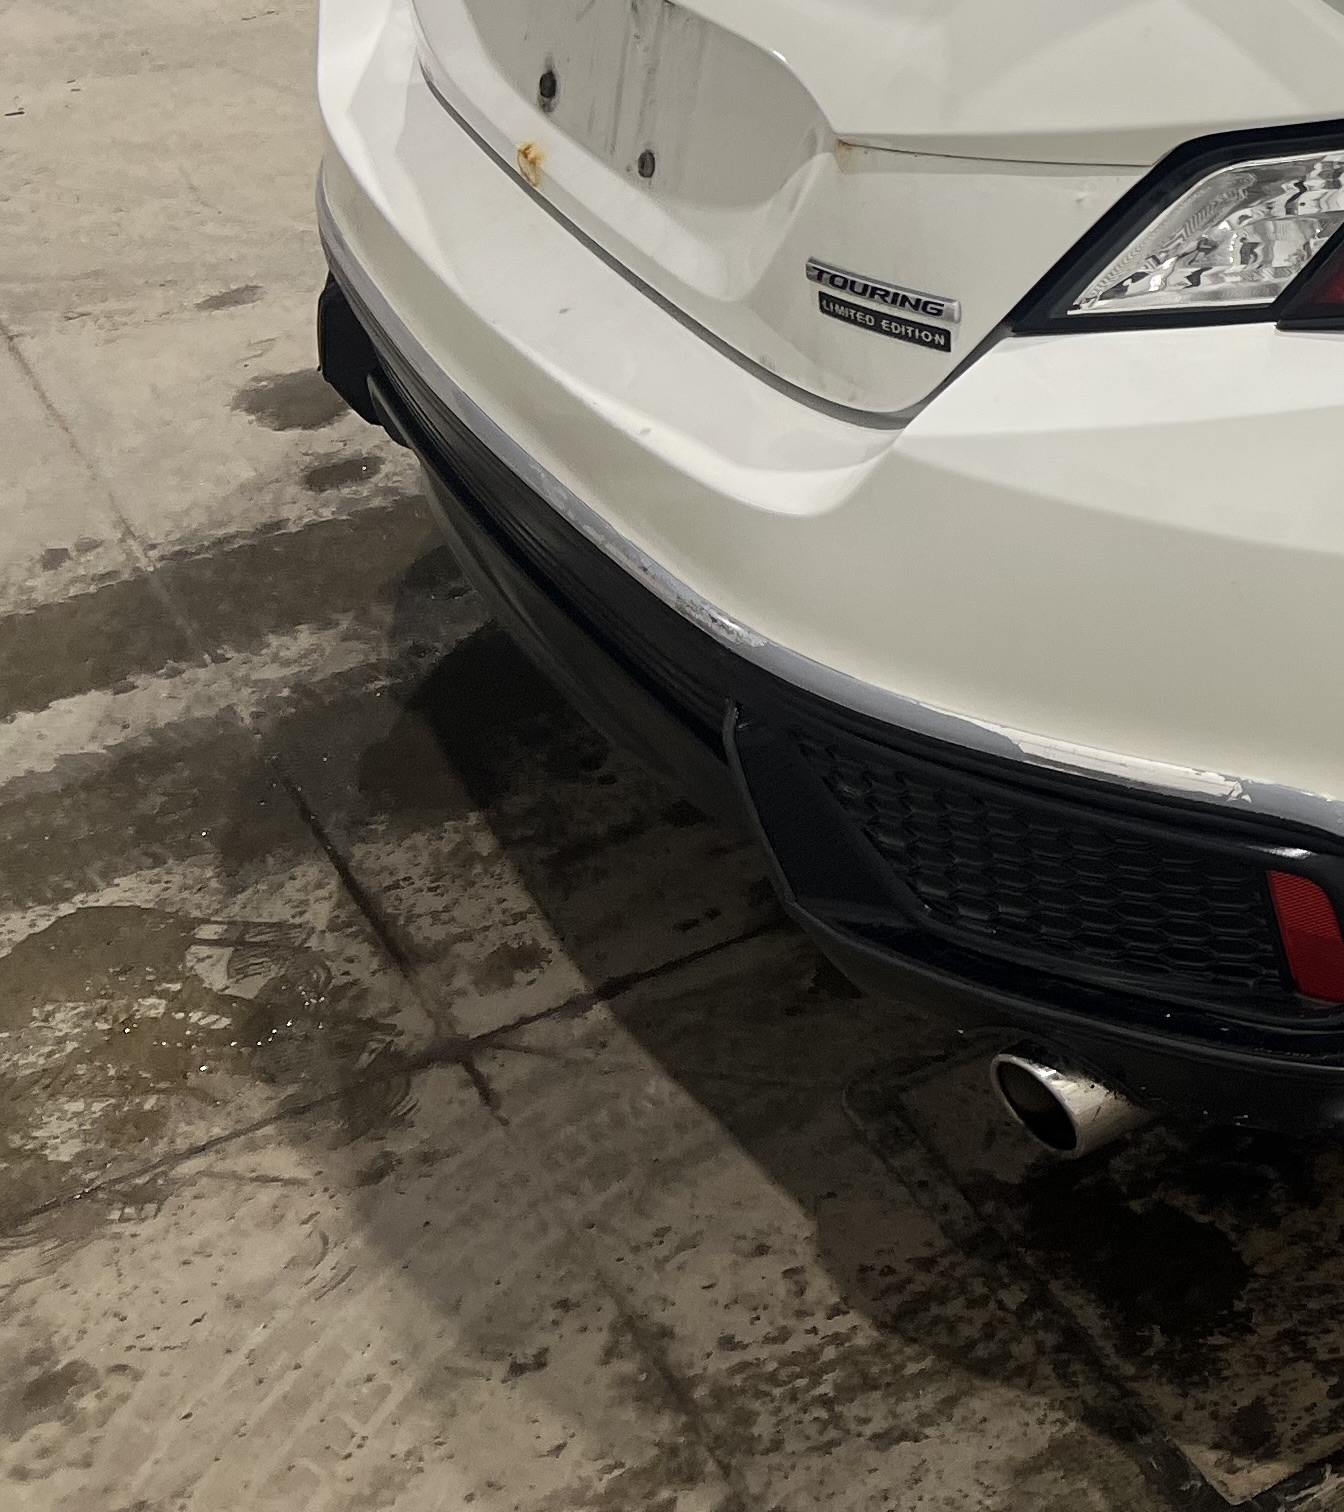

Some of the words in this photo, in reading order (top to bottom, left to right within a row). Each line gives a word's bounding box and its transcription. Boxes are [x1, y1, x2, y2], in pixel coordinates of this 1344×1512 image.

[812, 266, 945, 317] TOURING
[821, 299, 876, 326] LIMITED
[880, 319, 946, 346] EDITION
